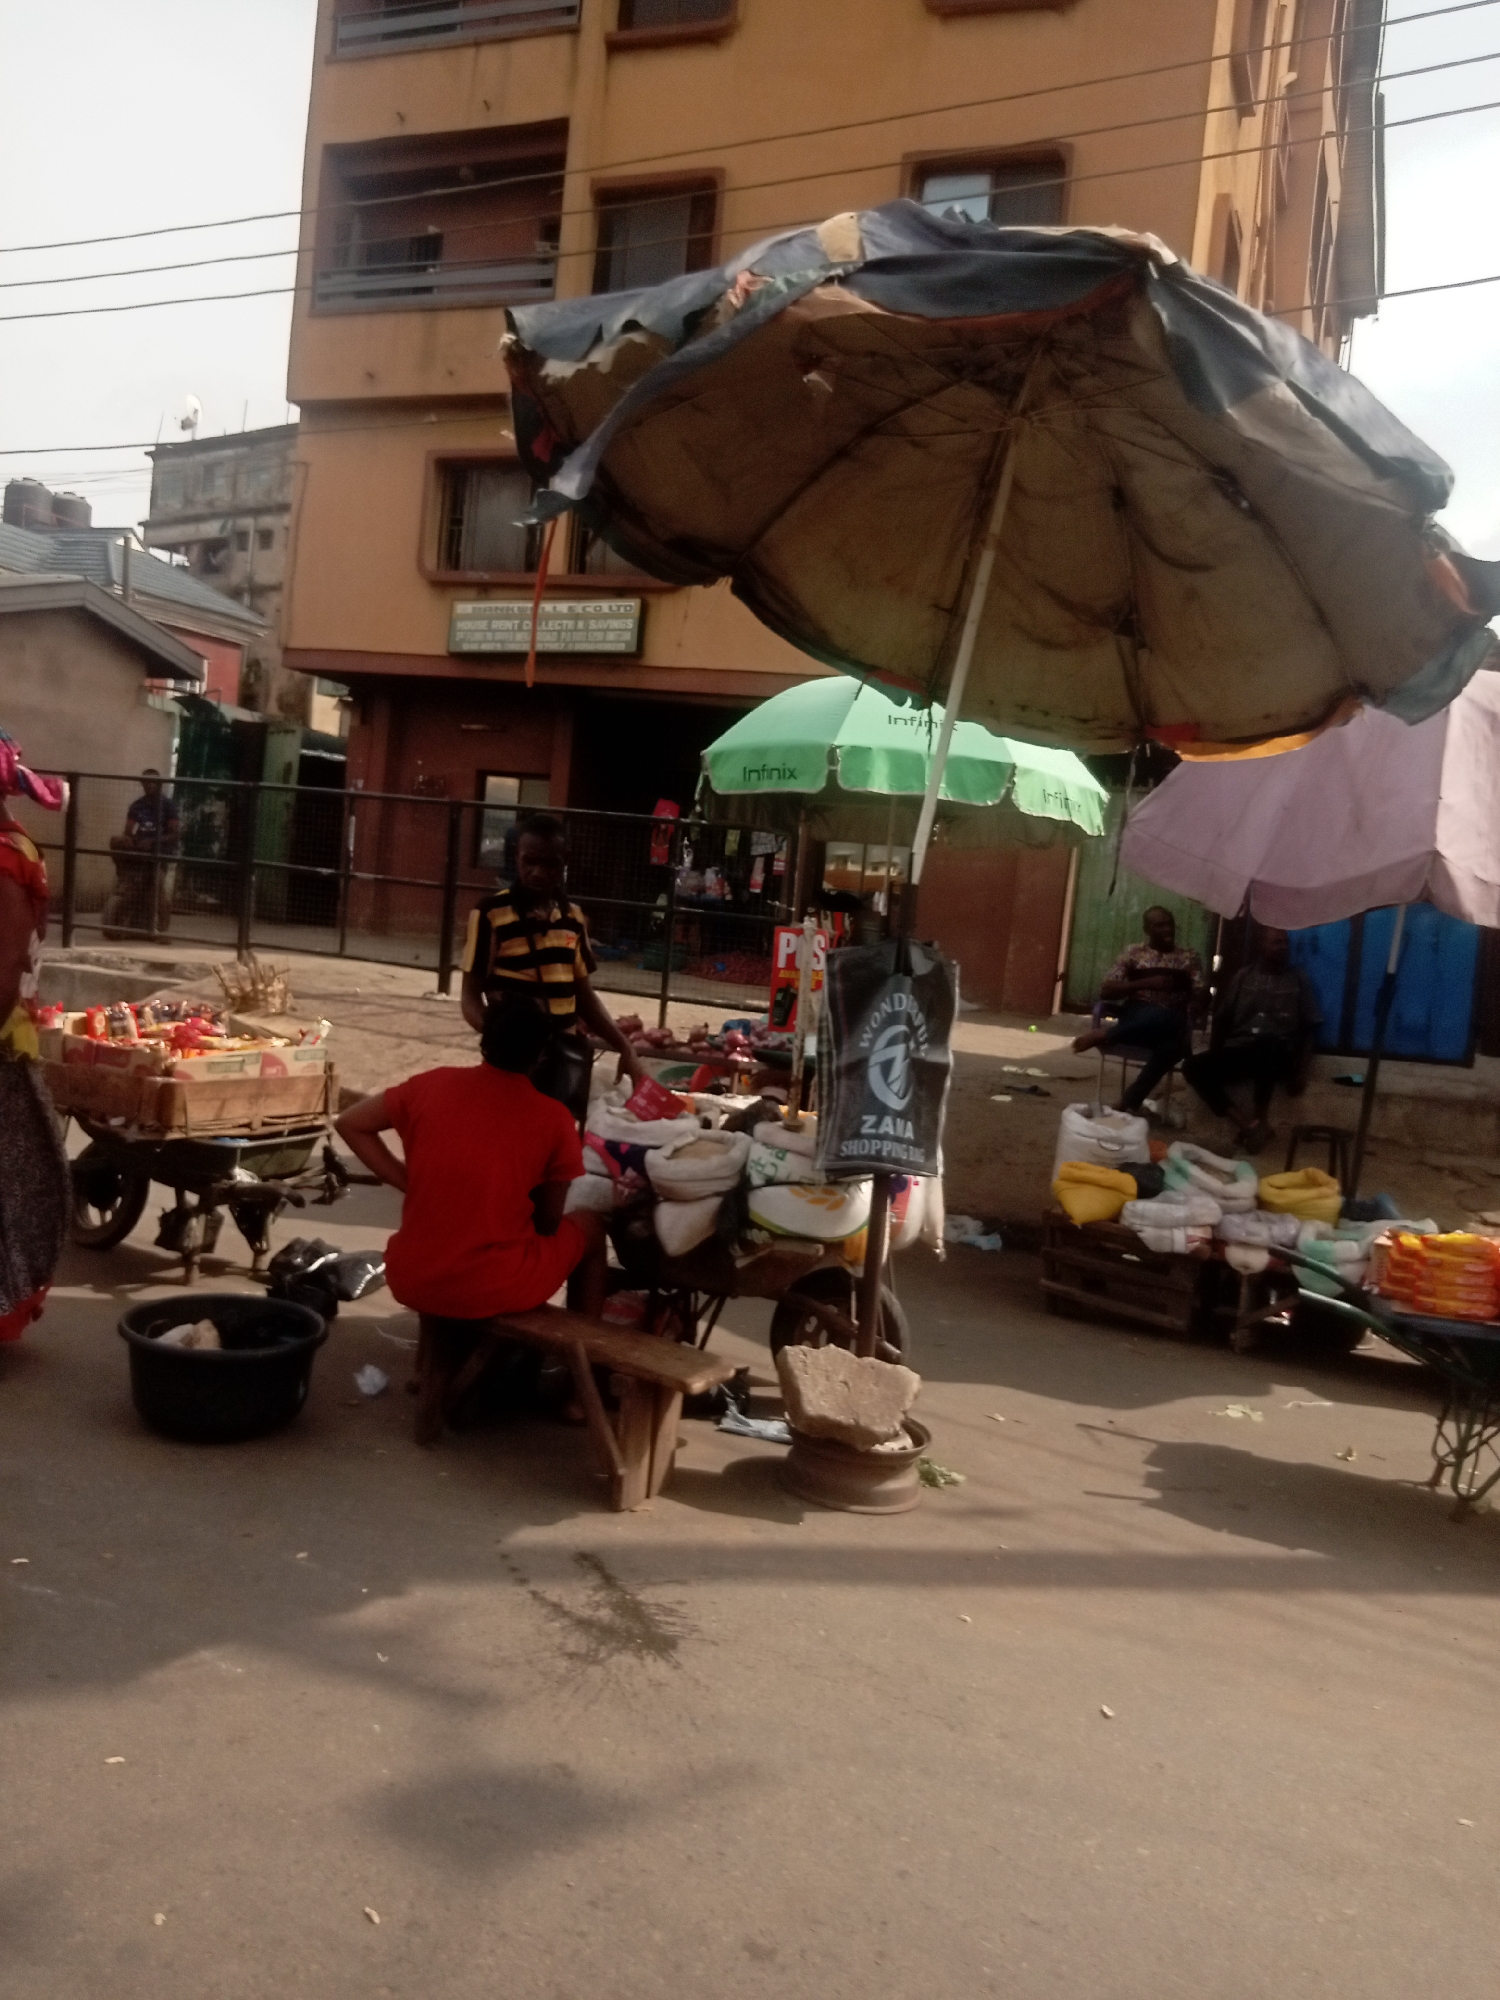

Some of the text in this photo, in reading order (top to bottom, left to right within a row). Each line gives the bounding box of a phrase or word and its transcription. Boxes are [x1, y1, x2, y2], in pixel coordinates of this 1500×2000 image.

[471, 605, 561, 614] BANKWLL
[608, 603, 633, 613] LTD
[457, 618, 634, 631] HOUSE RENT CLLECTIN SAVINGS
[742, 763, 798, 783] Infinix
